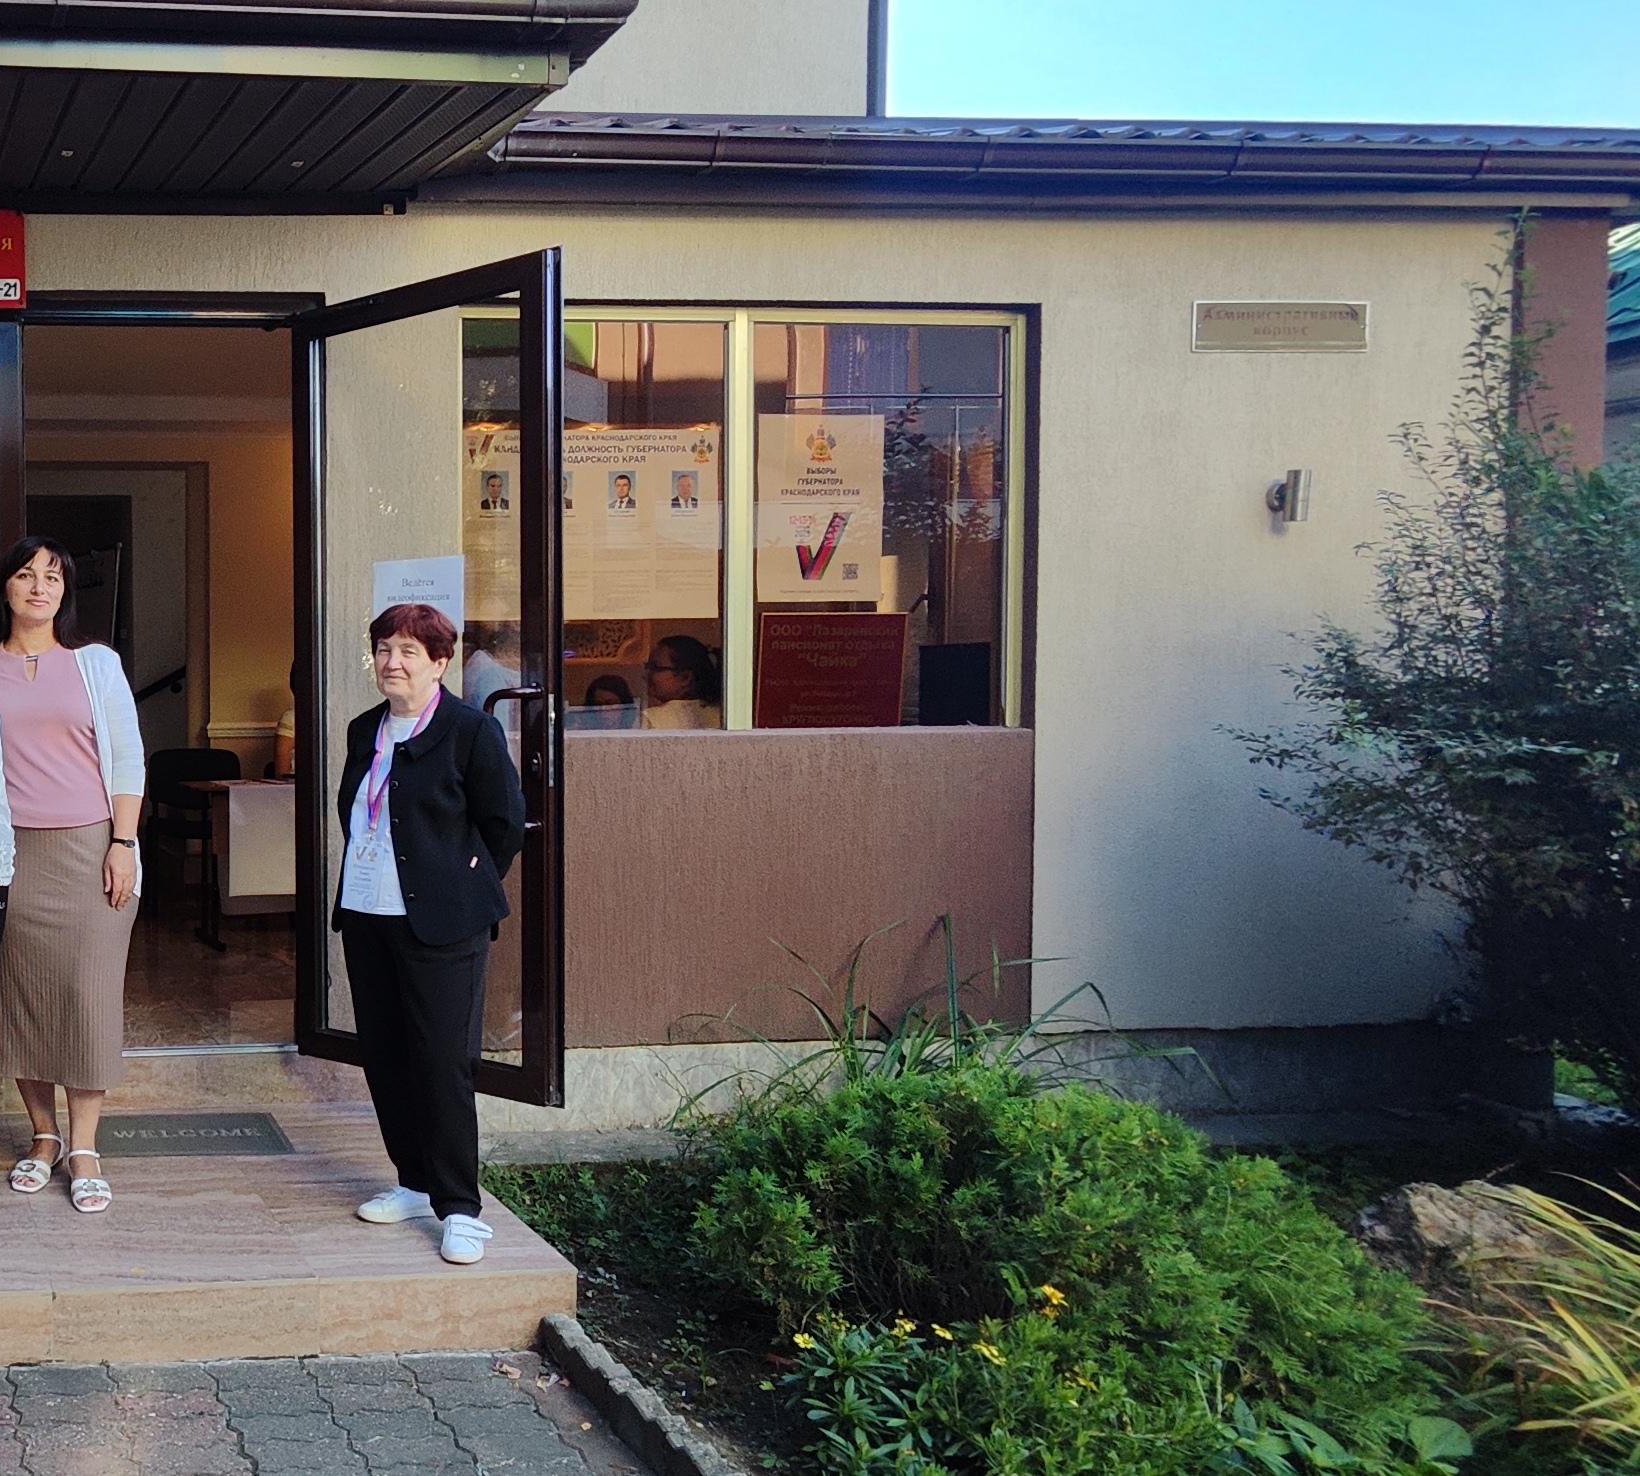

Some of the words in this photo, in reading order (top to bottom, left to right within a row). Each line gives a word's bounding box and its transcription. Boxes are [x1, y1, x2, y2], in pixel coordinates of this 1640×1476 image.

[1253, 326, 1310, 338] корпус
[568, 445, 624, 455] ДОЛЖНОСТЬ
[625, 445, 687, 454] ГУБЕРНАТОРА
[622, 455, 646, 464] КРАЯ
[806, 467, 837, 475] ВЫБОРЫ
[797, 478, 844, 486] ГУБЕРНАТОРА
[780, 488, 841, 497] КРАСНОДАРСКОГО
[842, 488, 860, 496] КРАЯ
[769, 624, 803, 637] ООО
[112, 1128, 263, 1139] WELCOME
